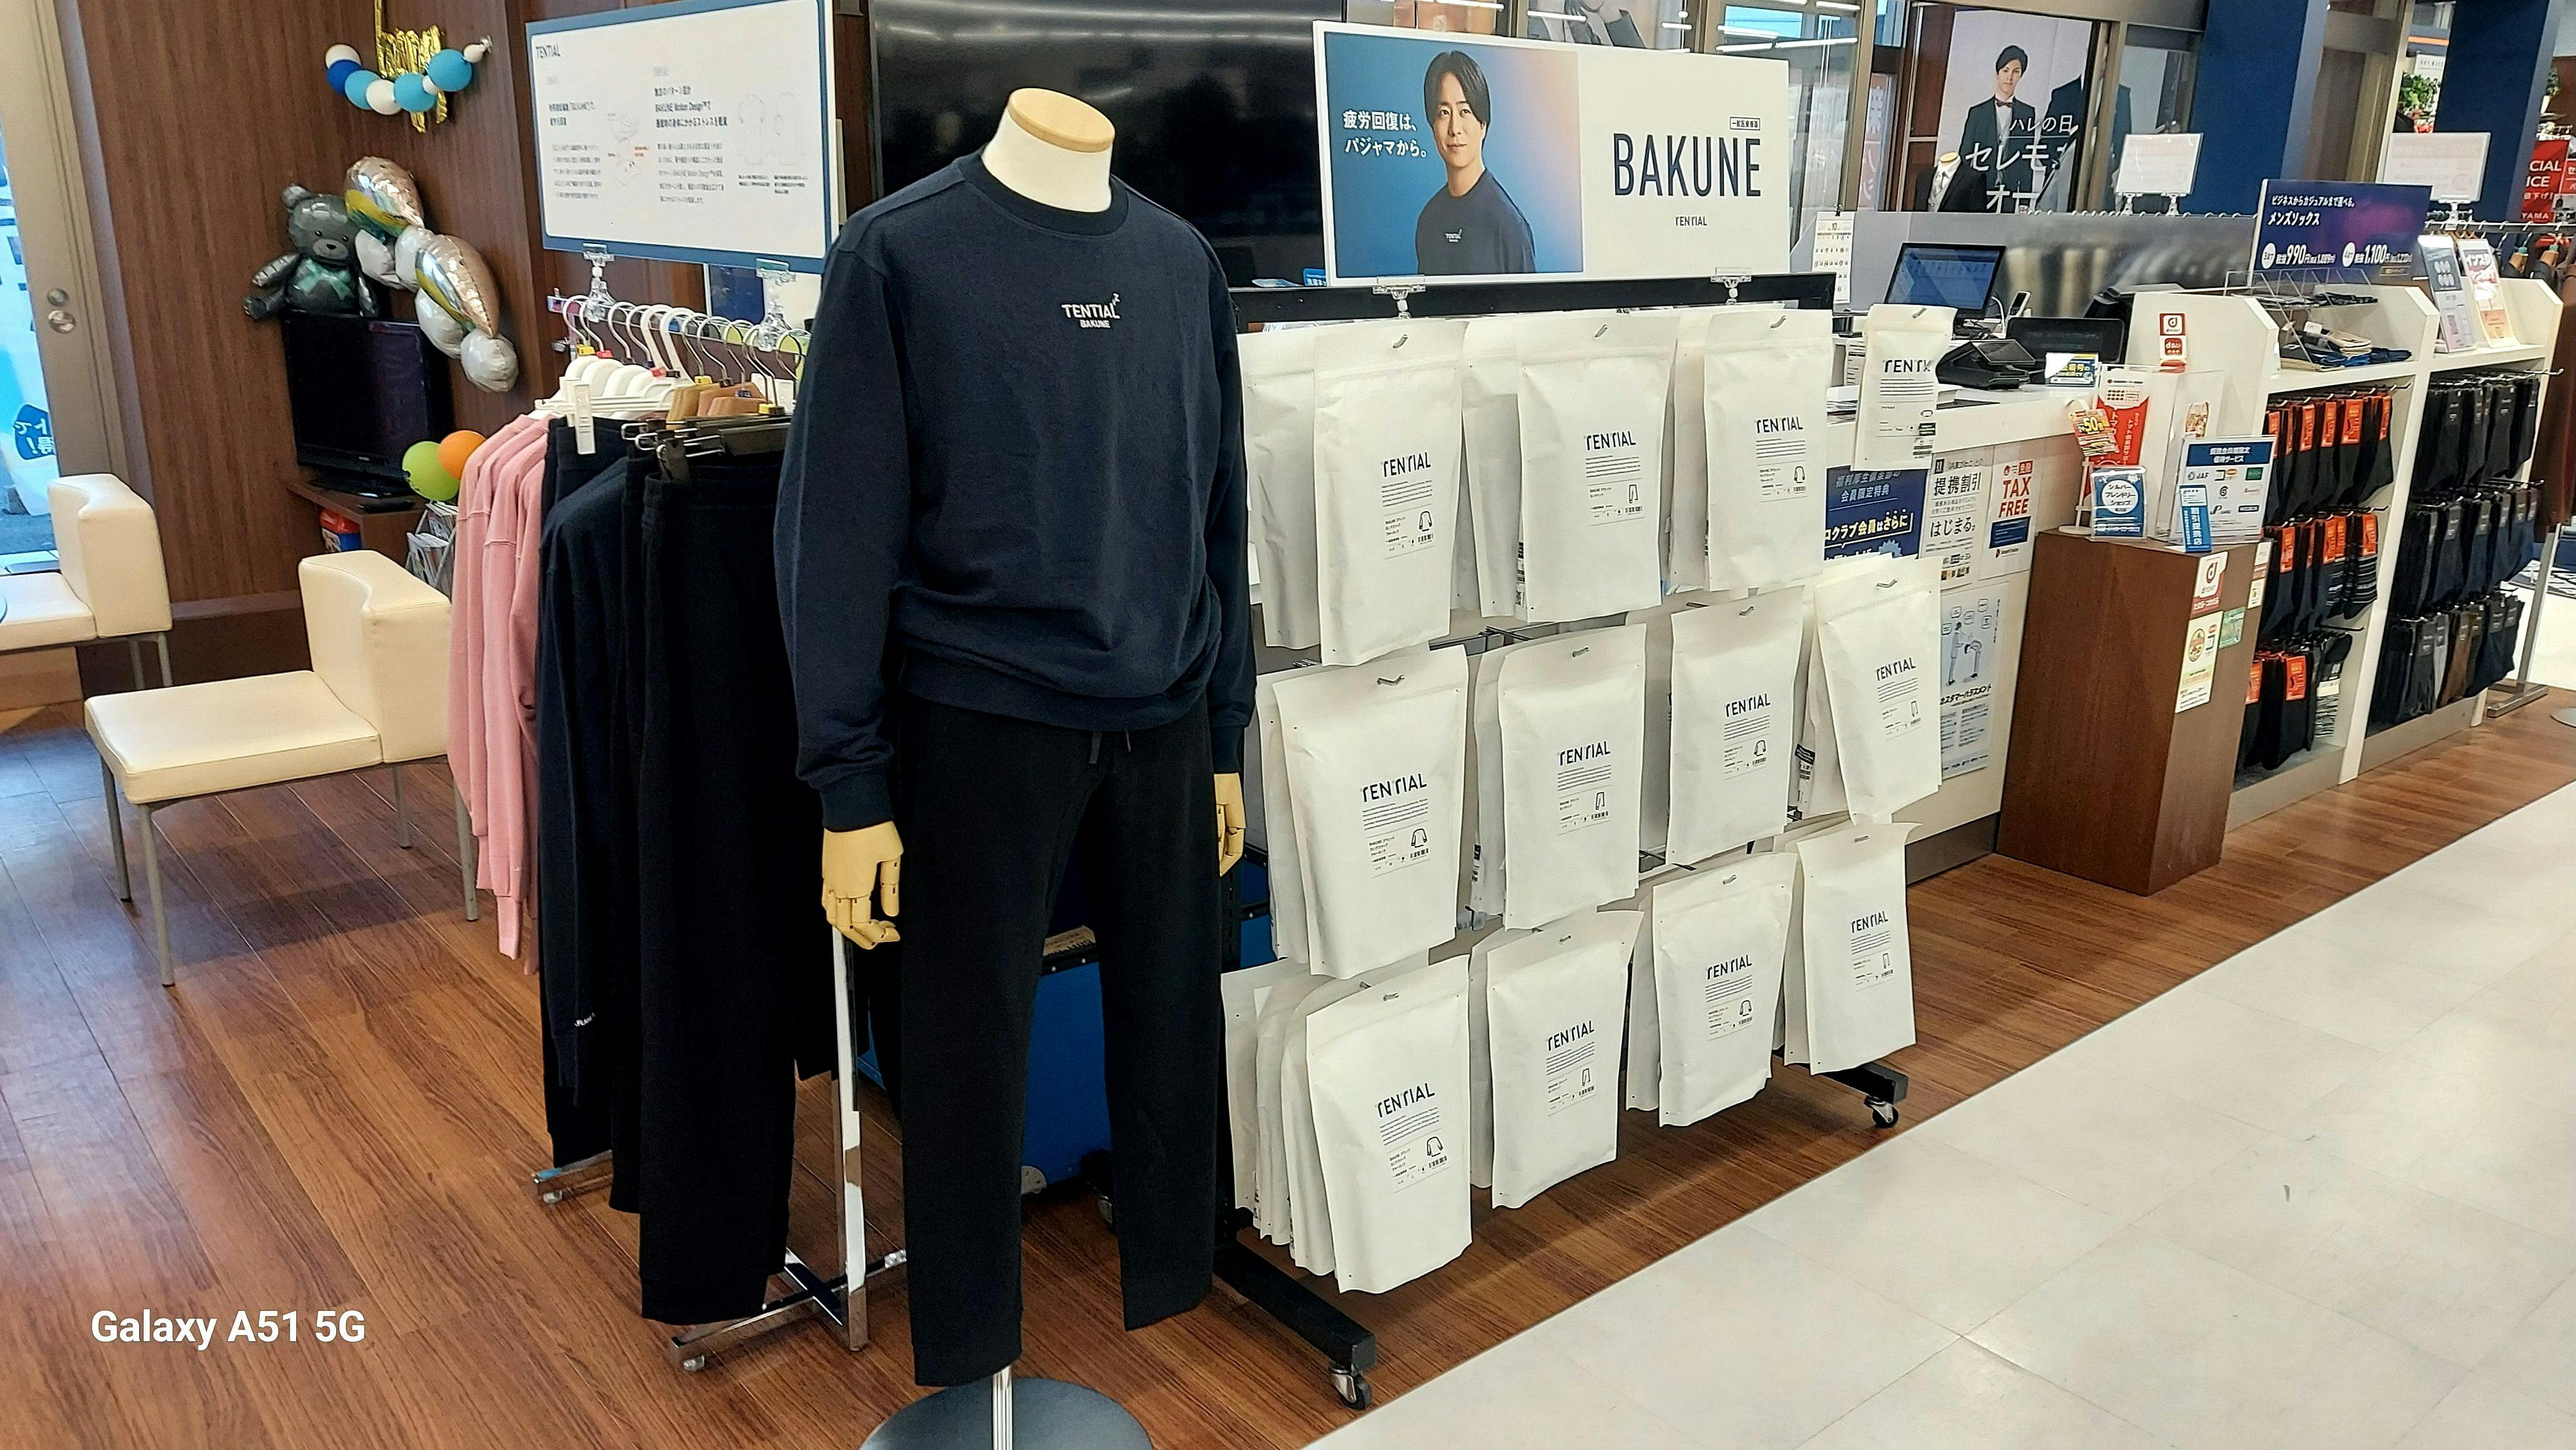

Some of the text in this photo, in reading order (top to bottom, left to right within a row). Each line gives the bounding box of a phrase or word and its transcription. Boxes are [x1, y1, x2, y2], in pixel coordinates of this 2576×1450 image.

[1343, 110, 1417, 131] 疲労回復は、
[2010, 115, 2073, 133] ハレの日
[1345, 137, 1427, 158] パジャマから。
[1613, 133, 1761, 197] BAKUNE
[2529, 160, 2562, 172] CIAL
[2526, 176, 2551, 187] ICE
[1674, 216, 1707, 227] TENTIAL
[2268, 211, 2320, 226] メンズソックス
[1061, 303, 1120, 319] TENTIAL
[1079, 319, 1111, 328] BAKUNE
[1755, 416, 1804, 434] TENTIAL
[1584, 431, 1636, 451] TENTIAL
[1381, 452, 1432, 478] TENTIAL
[1841, 484, 1890, 502] 会員限定特典
[1933, 472, 1982, 496] 提携割引
[2003, 476, 2031, 500] TAX
[1998, 498, 2030, 518] FREE
[1875, 657, 1917, 681] TENTIAL
[1724, 693, 1771, 717] TENTIAL
[1557, 741, 1611, 766] TENTIAL
[1360, 773, 1428, 803] TENTIAL
[1850, 910, 1889, 934] TENTIAL
[1705, 954, 1753, 981] TENTIAL
[1546, 1020, 1595, 1051] TENTIAL
[1374, 1082, 1435, 1118] TENTIAL
